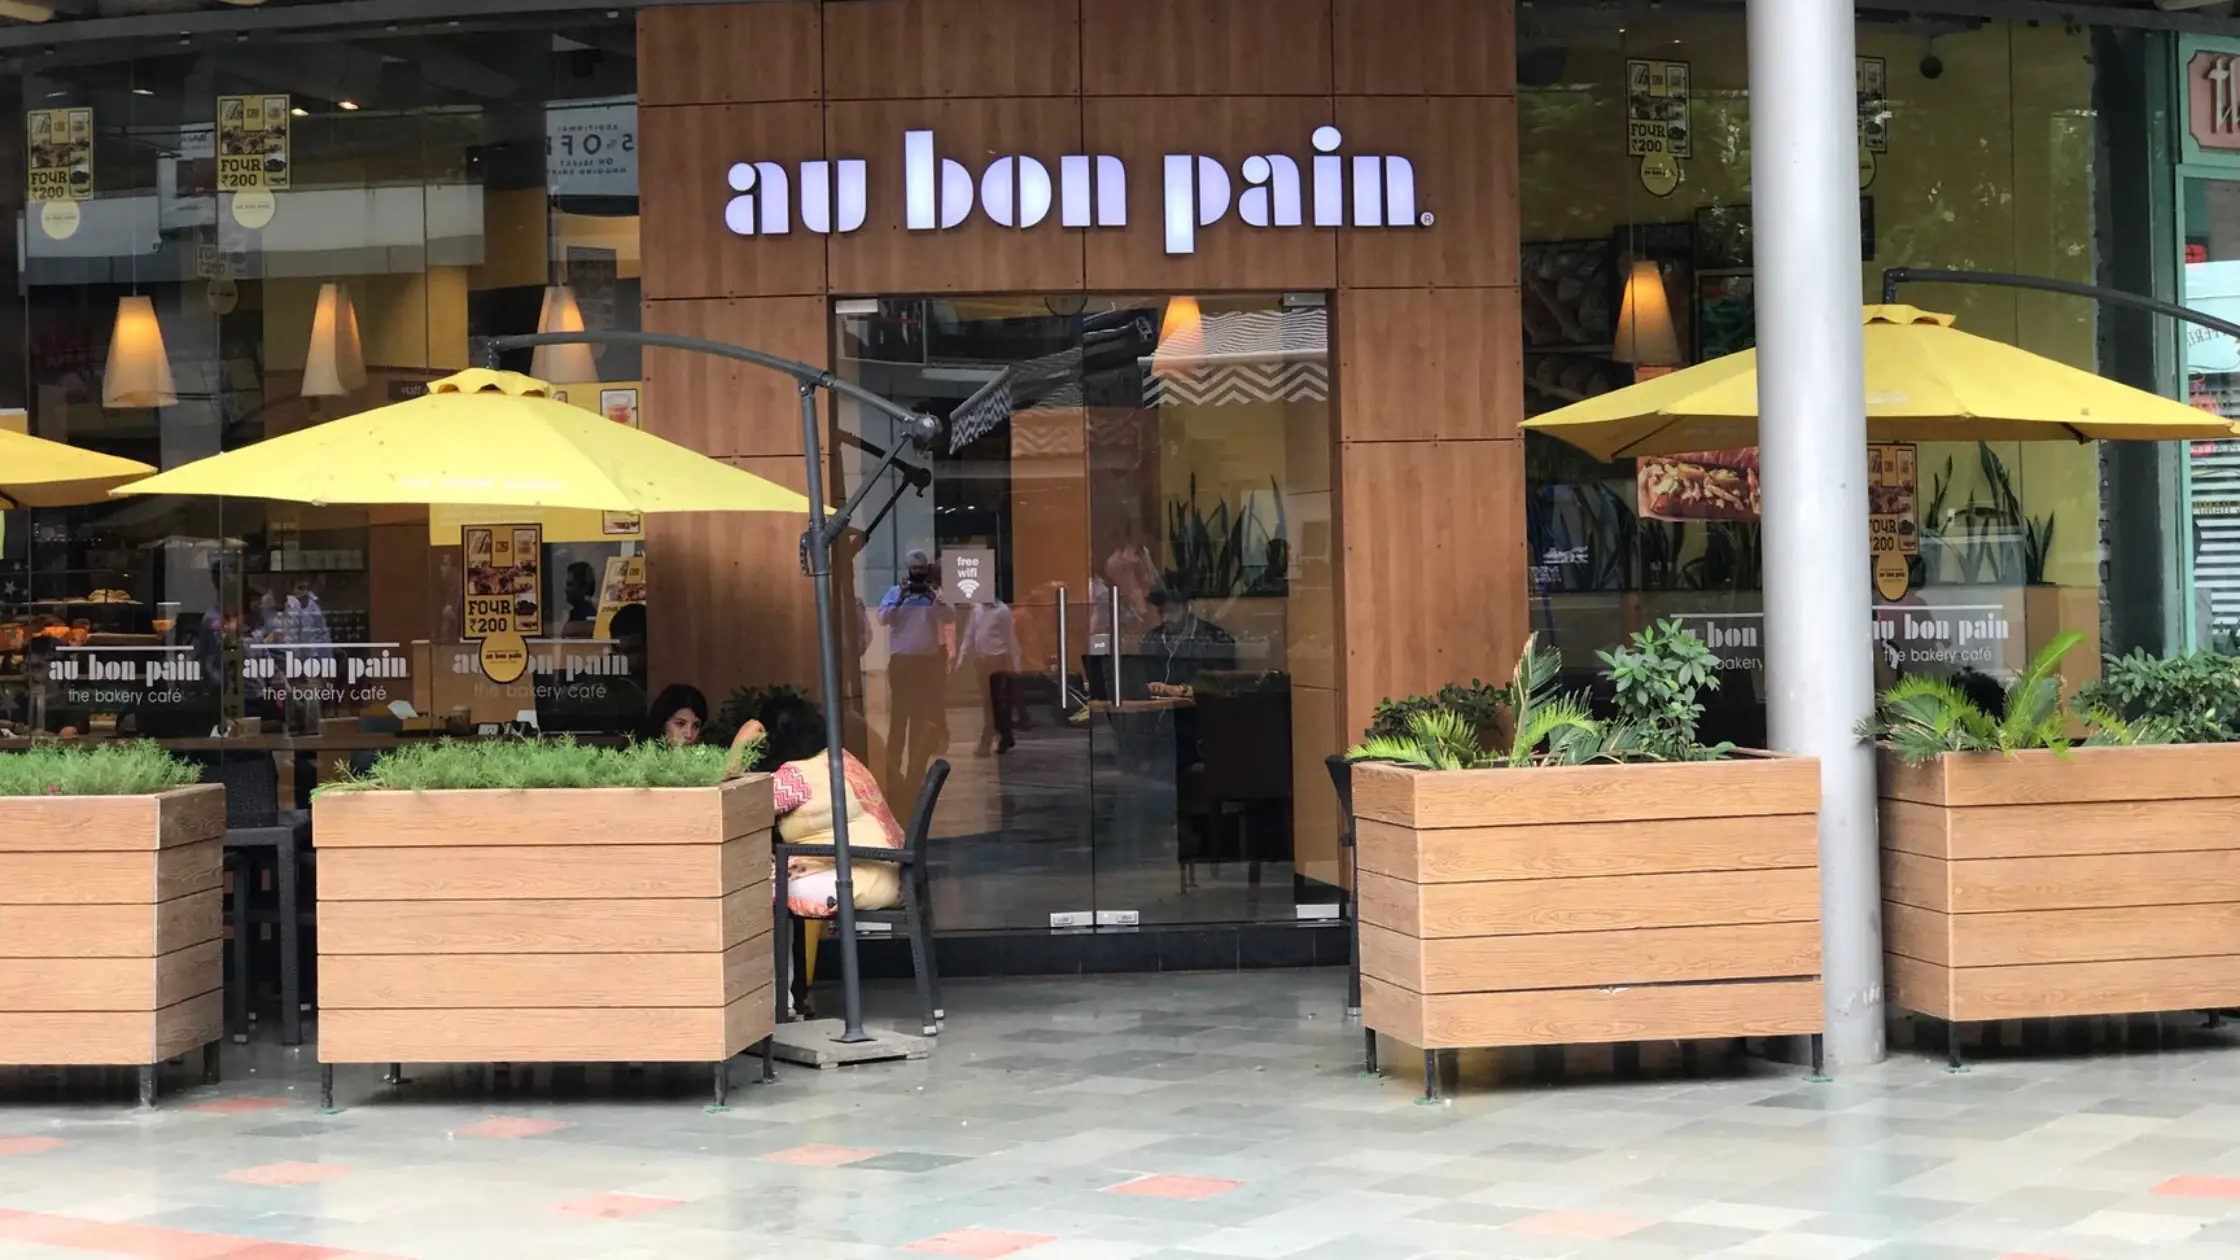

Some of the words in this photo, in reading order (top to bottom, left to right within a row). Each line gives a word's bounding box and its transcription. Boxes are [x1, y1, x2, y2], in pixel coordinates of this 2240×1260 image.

[725, 159, 867, 235] au
[905, 130, 1127, 229] bon
[1163, 125, 1415, 253] pain
[1870, 537, 1894, 550] 200
[957, 556, 979, 566] free
[957, 567, 978, 578] wifi
[1707, 621, 1757, 647] bon
[1904, 613, 1949, 640] bon
[1958, 612, 2009, 645] pain
[566, 647, 629, 682] pain
[1910, 648, 1957, 664] bakery
[1960, 646, 1992, 661] café
[49, 660, 79, 680] au
[88, 654, 136, 680] bon
[146, 653, 201, 687] pain
[242, 658, 275, 679] au
[286, 650, 337, 679] bon
[348, 649, 407, 684] pain
[68, 688, 90, 702] the
[95, 688, 143, 705] bakery
[148, 687, 182, 702] café
[262, 686, 287, 701] the
[293, 686, 345, 704] bakery
[350, 685, 387, 701] café
[474, 683, 500, 698] the
[506, 683, 562, 700] bakery
[568, 683, 607, 699] café
